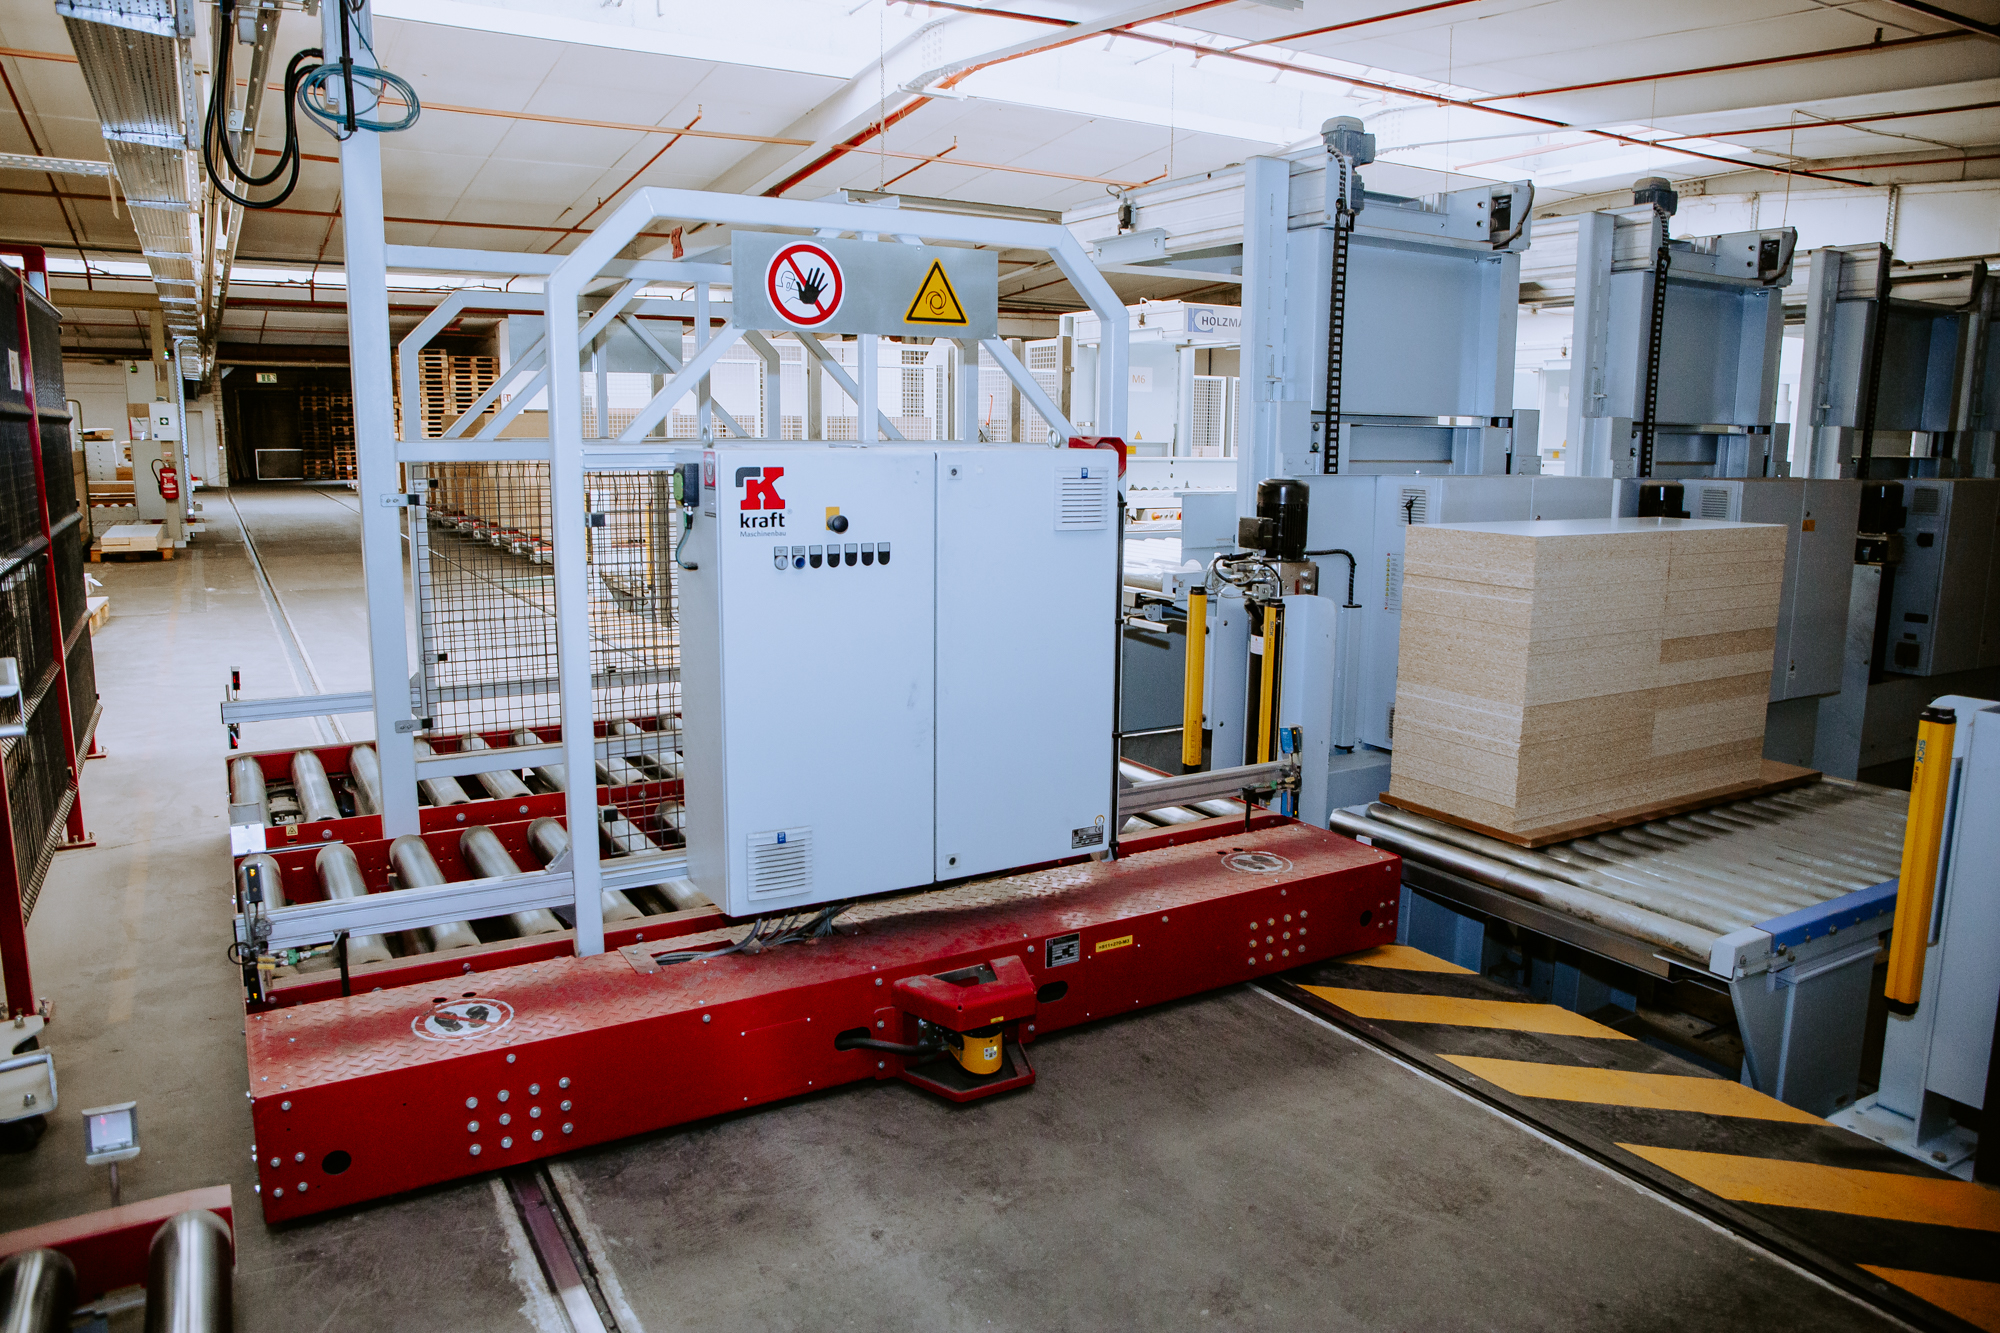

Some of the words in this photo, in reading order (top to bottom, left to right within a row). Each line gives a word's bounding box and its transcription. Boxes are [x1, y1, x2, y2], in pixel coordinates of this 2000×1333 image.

[1132, 374, 1145, 384] M6
[740, 512, 785, 528] kraft
[740, 530, 786, 538] Maschinenbau
[1916, 739, 1925, 764] SICK
